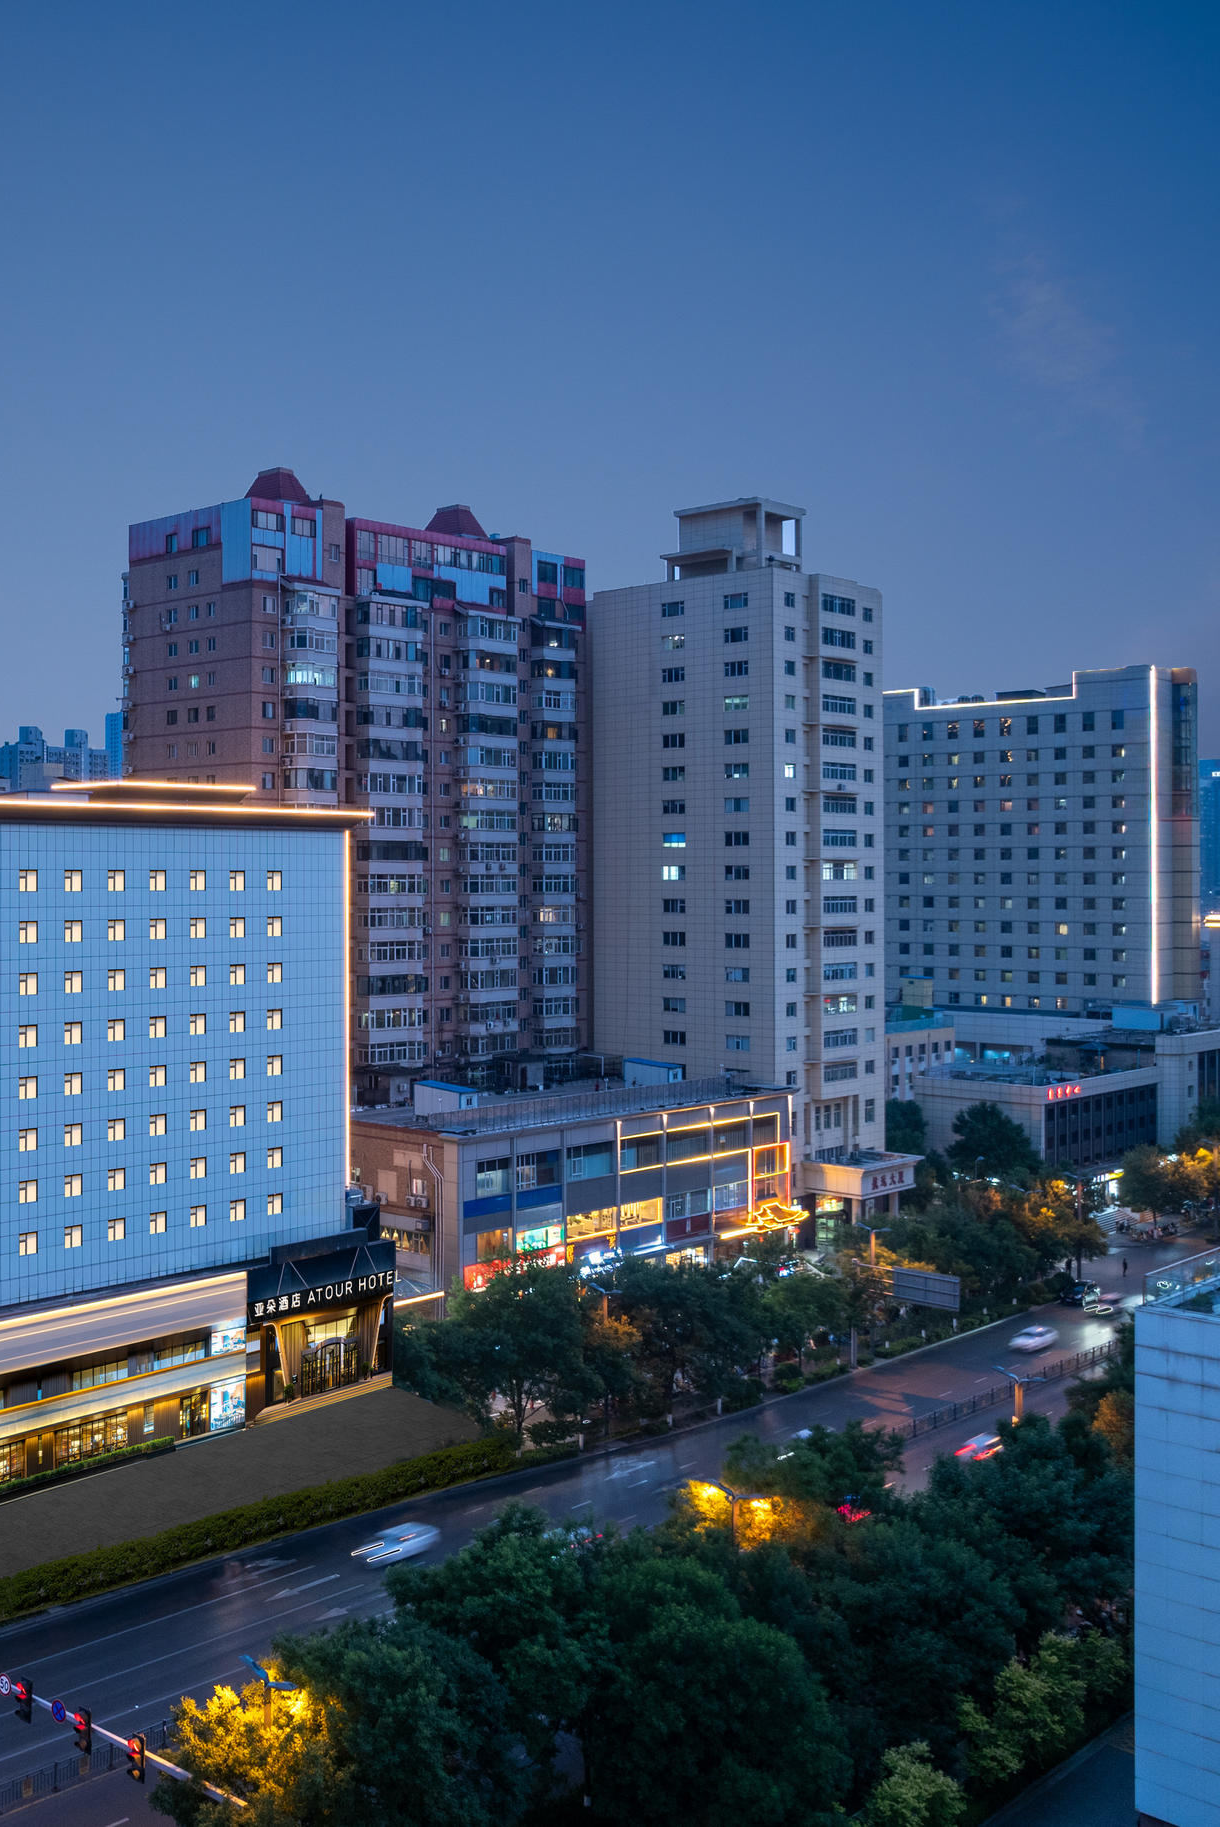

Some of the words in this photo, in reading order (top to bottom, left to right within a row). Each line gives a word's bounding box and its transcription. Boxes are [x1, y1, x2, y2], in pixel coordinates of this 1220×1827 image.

[254, 1293, 301, 1317] 亚朵酒店
[307, 1281, 353, 1304] ATOUR
[358, 1269, 402, 1292] HOTEL
[0, 1678, 8, 1691] 50
